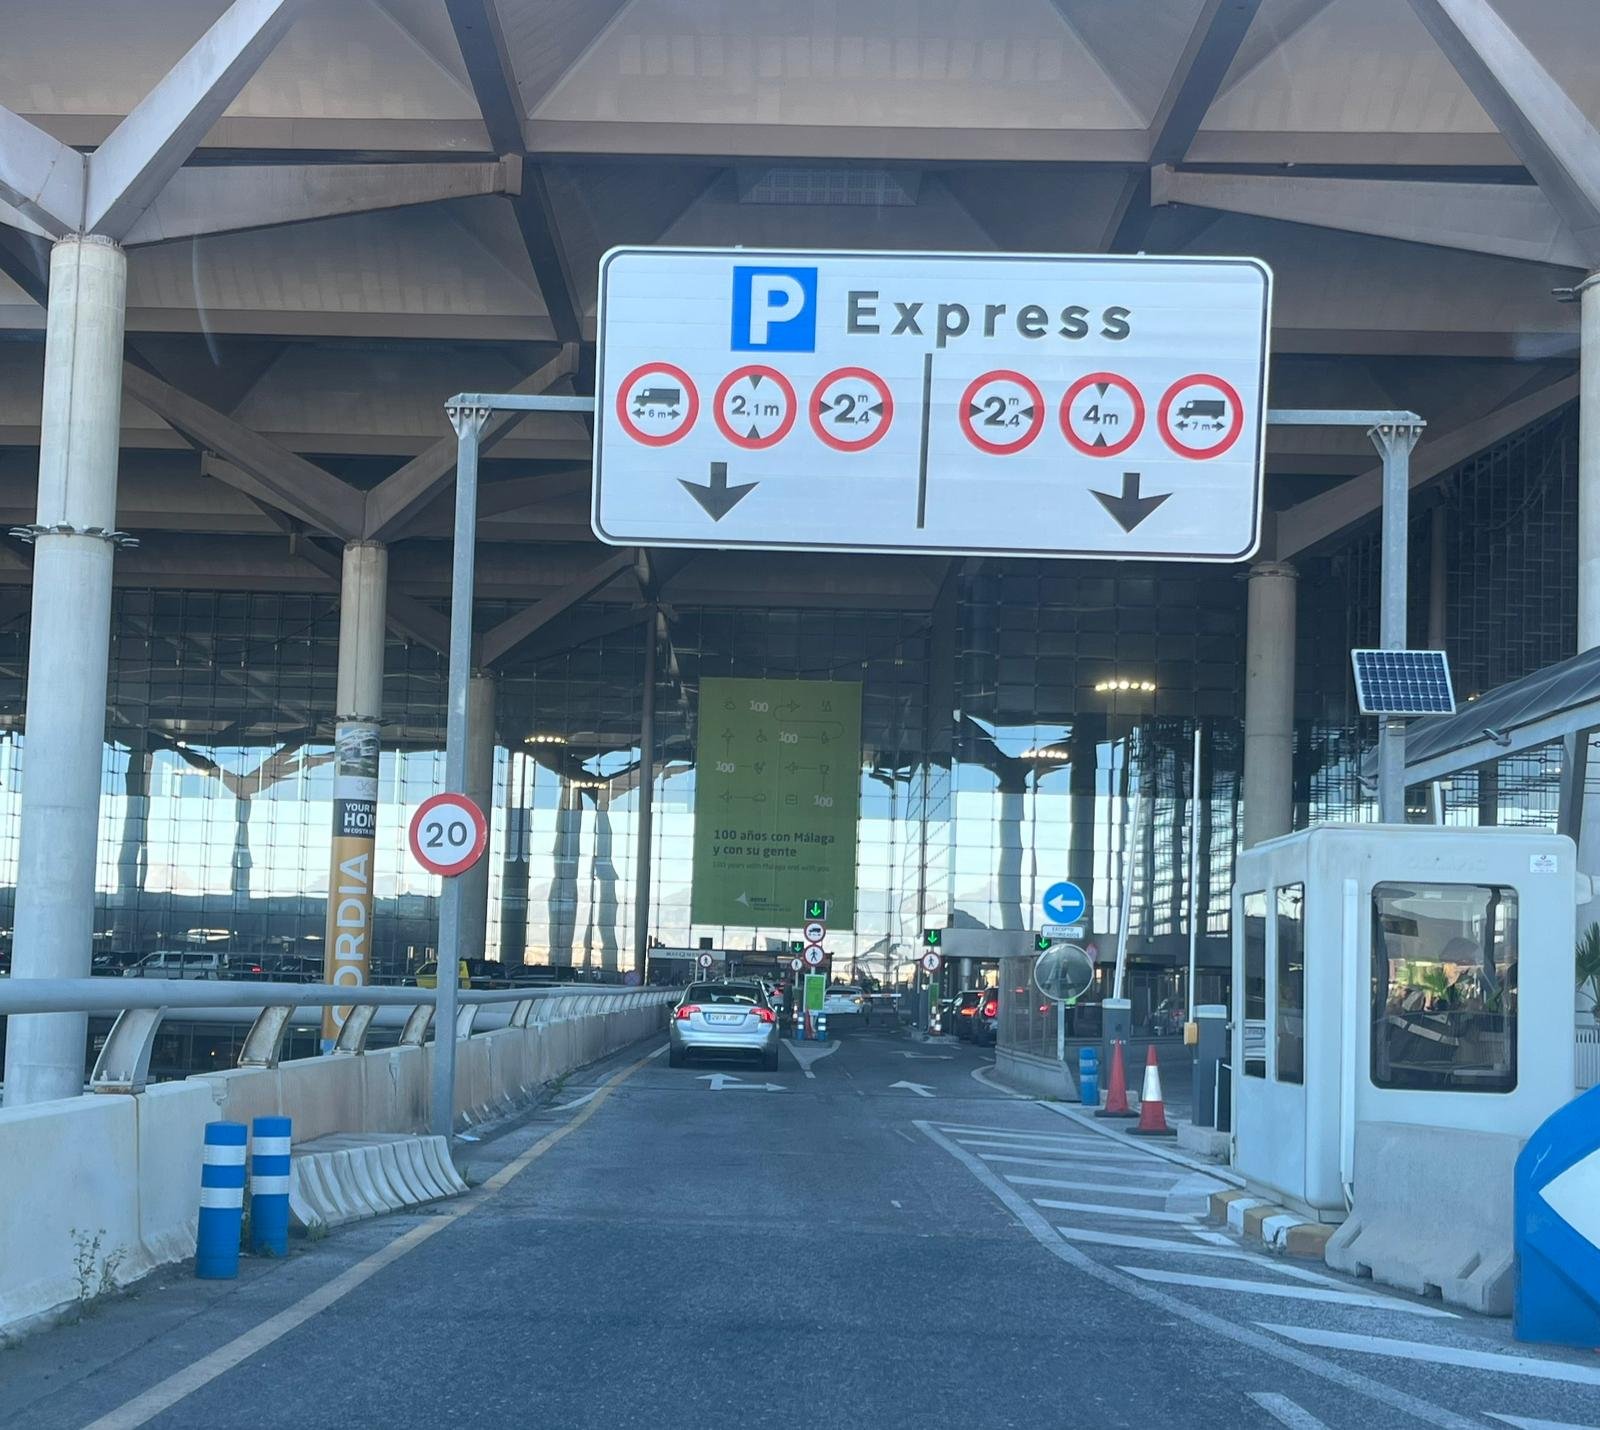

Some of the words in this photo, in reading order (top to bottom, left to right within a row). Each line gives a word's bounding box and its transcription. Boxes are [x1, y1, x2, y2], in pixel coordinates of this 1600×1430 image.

[749, 274, 804, 345] P
[847, 290, 1132, 348] Express
[648, 409, 655, 418] 6
[1191, 422, 1198, 431] 7
[750, 700, 769, 713] 100
[779, 731, 798, 744] 100
[715, 761, 735, 773] 100
[814, 794, 833, 807] 100
[345, 803, 370, 812] YOUR
[426, 821, 467, 848] 20
[714, 830, 737, 840] 100
[740, 830, 768, 841] años
[771, 832, 790, 842] con
[794, 832, 835, 846] Málaga
[713, 846, 720, 856] y
[723, 846, 743, 855] con
[746, 847, 760, 855] su
[763, 847, 797, 858] gente
